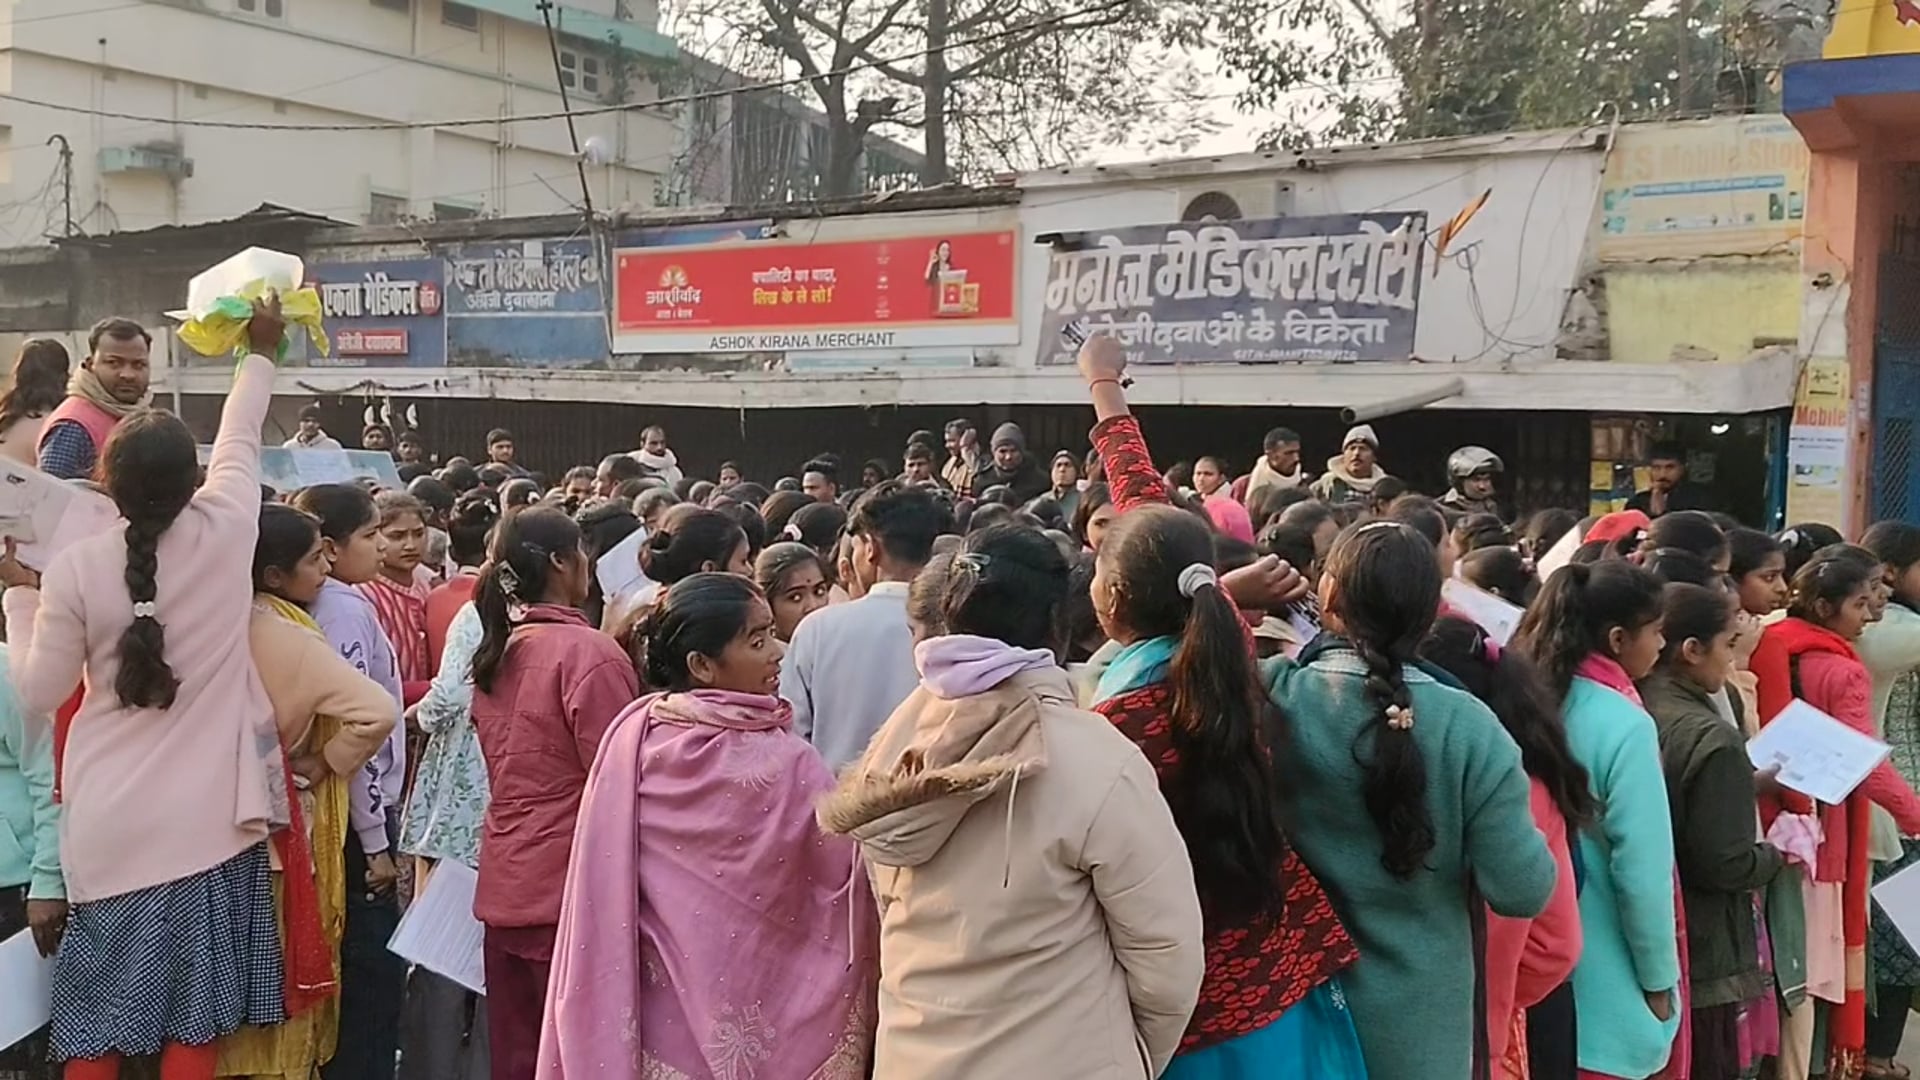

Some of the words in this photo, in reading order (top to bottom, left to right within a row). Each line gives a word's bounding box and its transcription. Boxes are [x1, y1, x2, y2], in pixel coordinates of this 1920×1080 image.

[1047, 236, 1154, 313] मनोज
[1155, 226, 1319, 301] मेडिकल
[322, 282, 363, 317] एकता
[363, 272, 419, 316] मेडिकल
[645, 286, 702, 307] आशीर्वाद
[1244, 307, 1278, 344] के
[1281, 306, 1390, 345] विक्रेता
[710, 336, 755, 350] ASHOK
[759, 335, 811, 349] KIRANA
[815, 332, 896, 347] MERCHANT
[1795, 405, 1847, 427] Mobile
